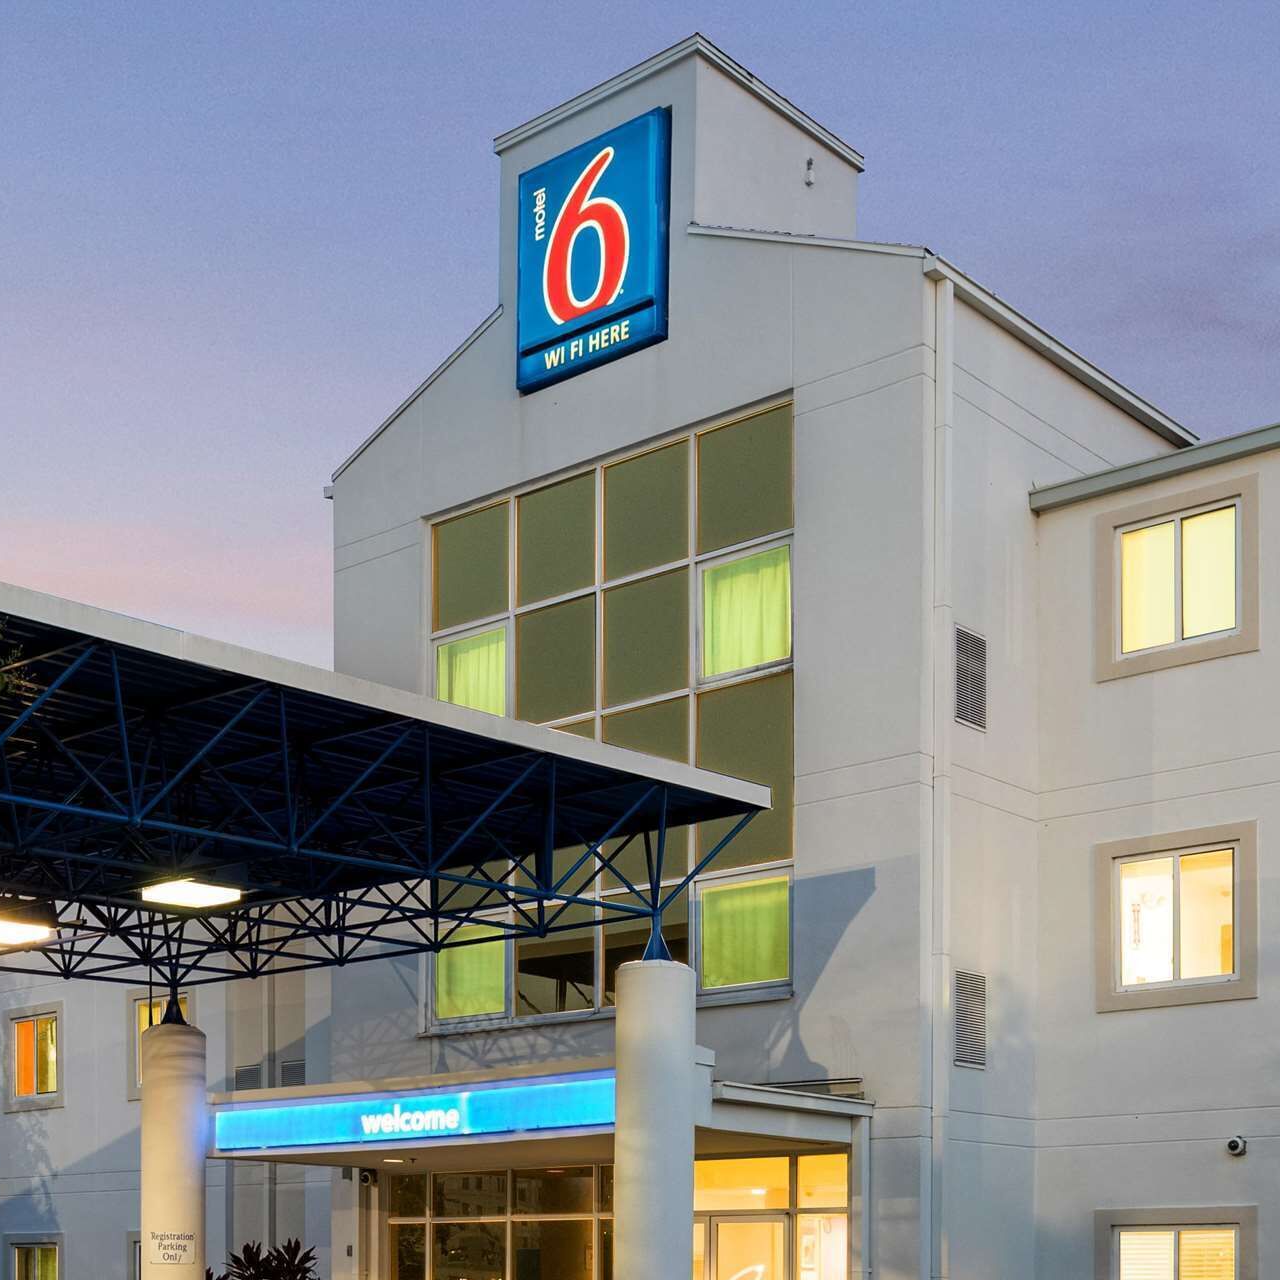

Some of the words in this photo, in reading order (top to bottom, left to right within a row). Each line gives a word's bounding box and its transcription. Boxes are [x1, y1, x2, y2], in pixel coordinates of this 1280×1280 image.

[533, 187, 546, 242] motel
[542, 146, 630, 326] 6
[544, 345, 565, 370] WI
[570, 338, 583, 361] FI
[588, 319, 630, 353] HERE
[360, 1103, 460, 1135] welcome
[150, 1231, 195, 1242] Registration
[158, 1242, 188, 1253] Parking
[162, 1252, 183, 1263] Only
